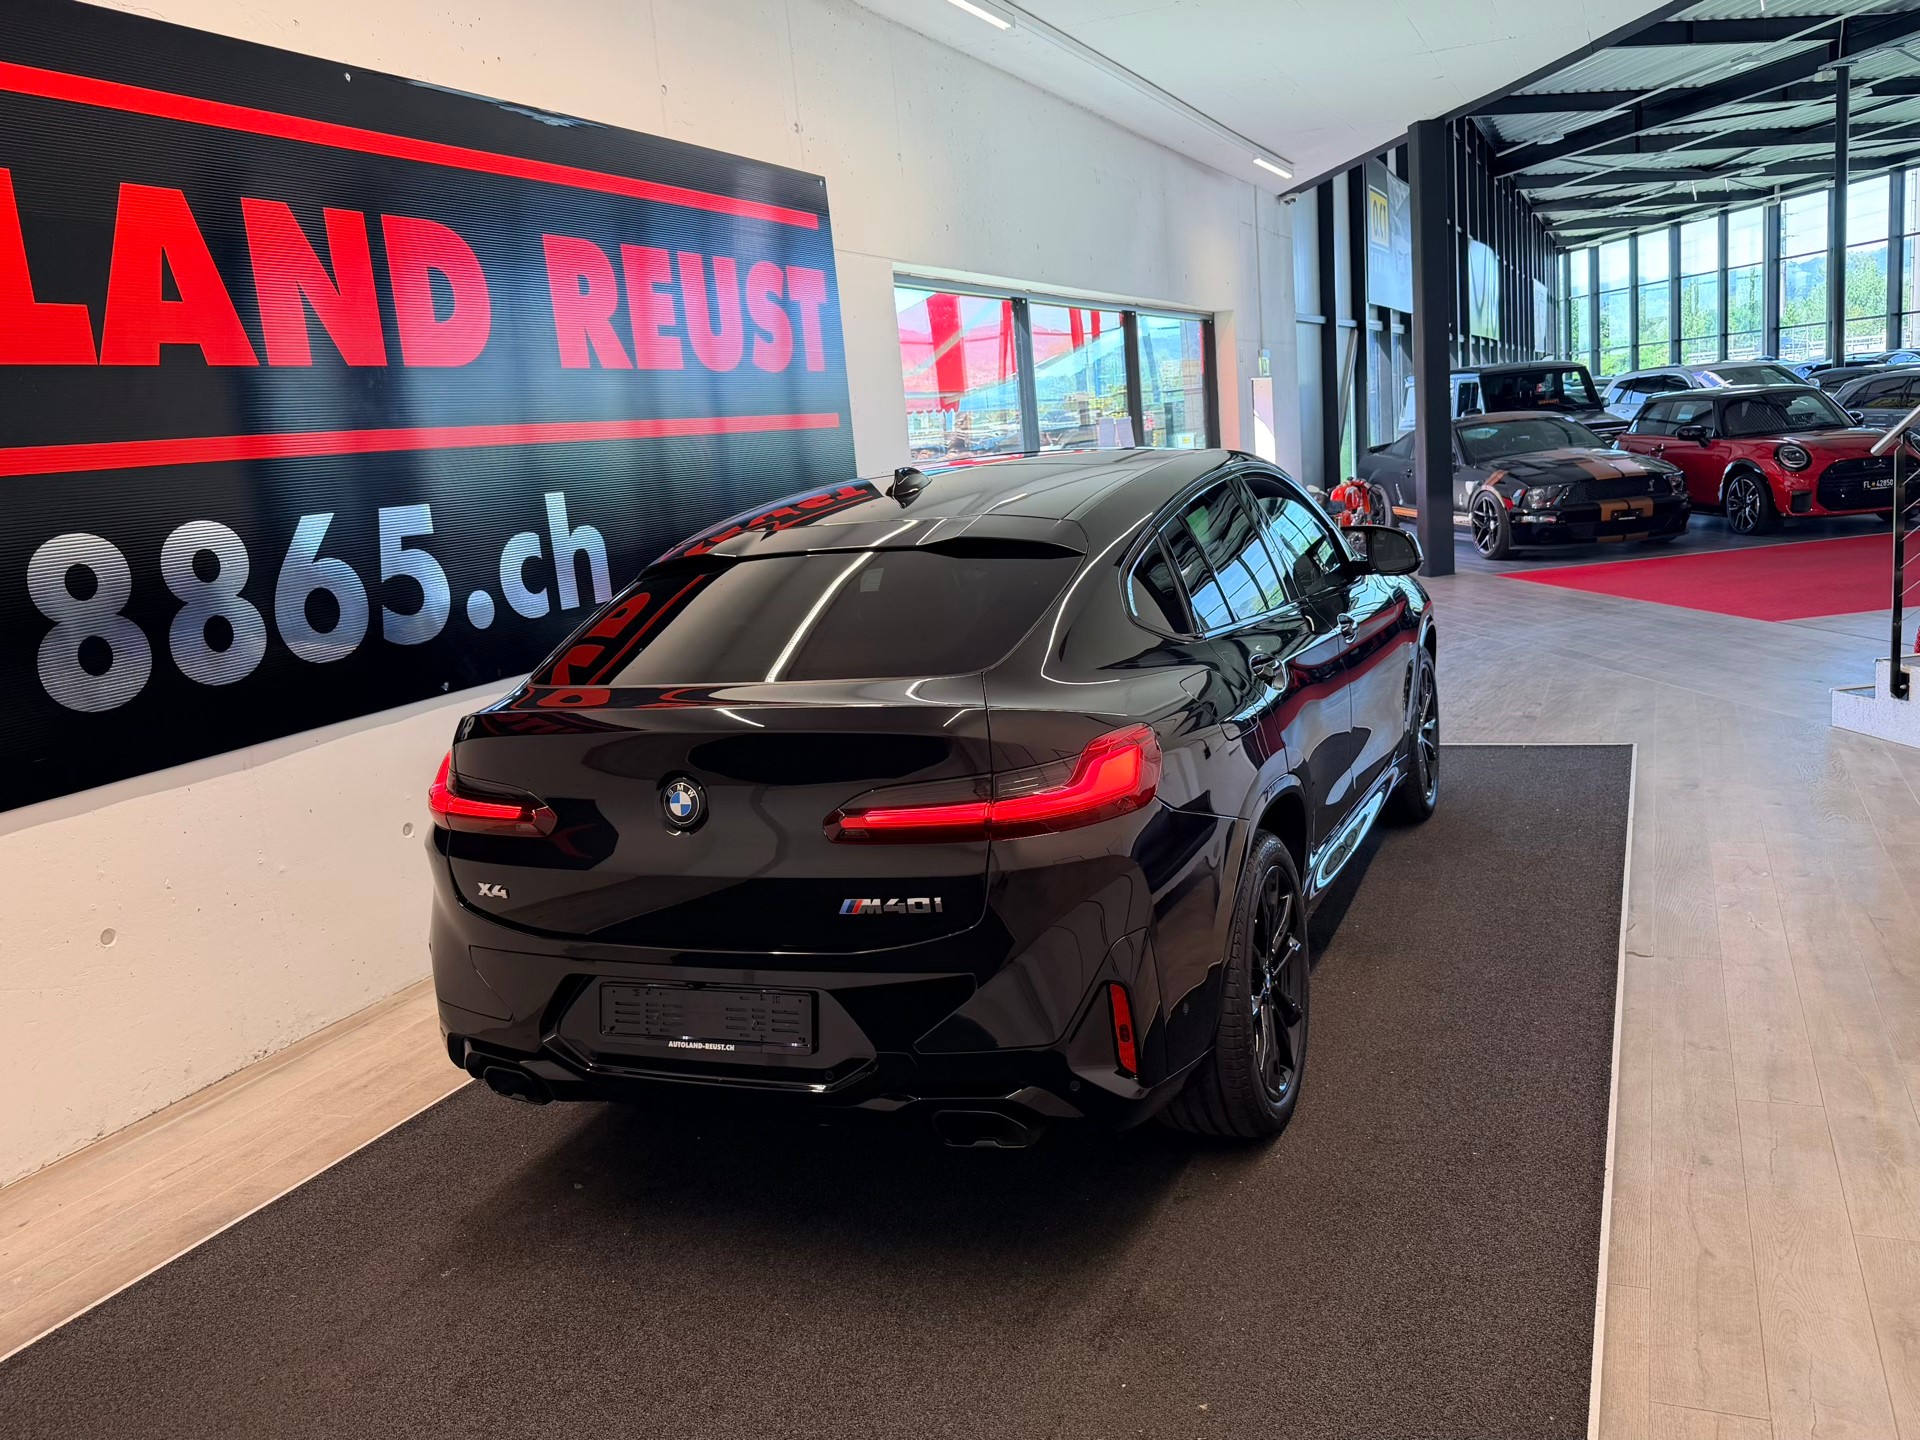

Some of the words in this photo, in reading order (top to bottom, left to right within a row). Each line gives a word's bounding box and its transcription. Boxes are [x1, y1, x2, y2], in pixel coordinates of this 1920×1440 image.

[541, 233, 826, 373] REUST
[1863, 480, 1871, 489] FL
[26, 491, 614, 714] 8865.ch
[667, 784, 696, 798] BMW
[477, 882, 508, 899] X4
[857, 896, 943, 915] M40i
[668, 1040, 735, 1052] AUTOLAND-REUST.CH
